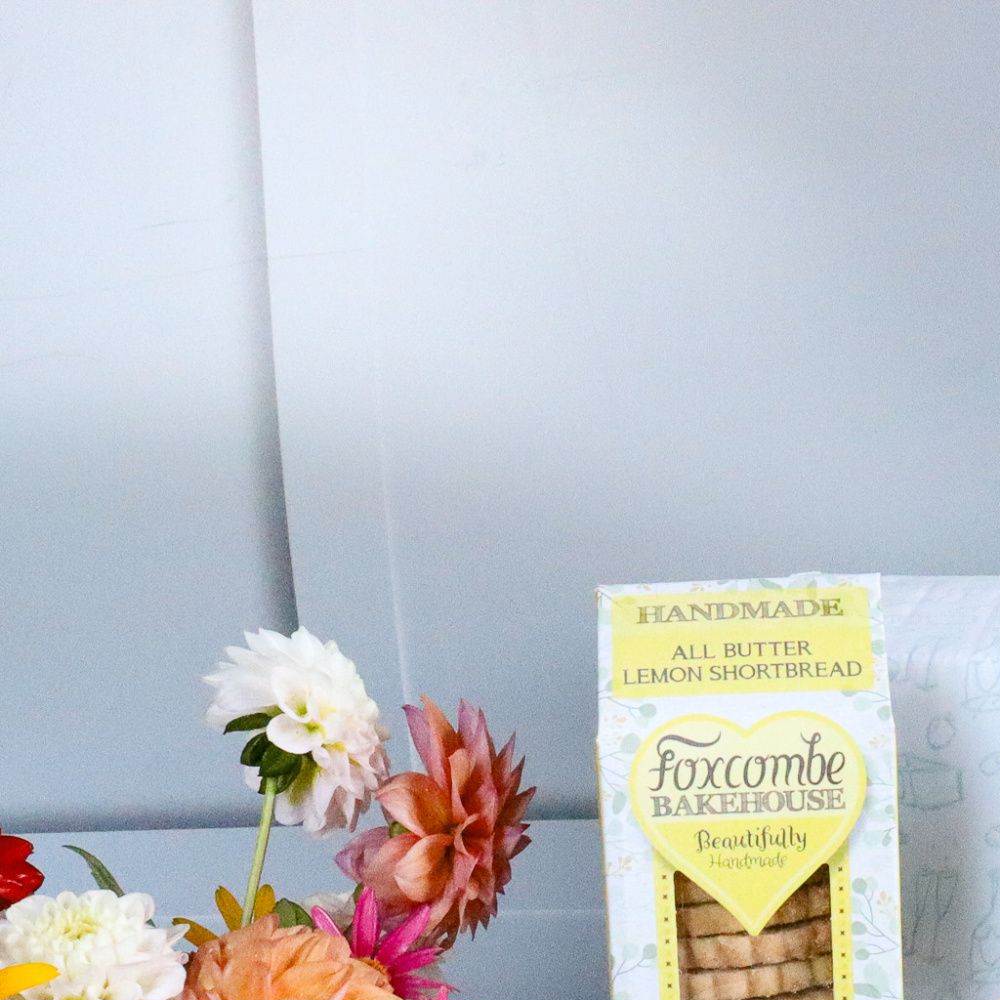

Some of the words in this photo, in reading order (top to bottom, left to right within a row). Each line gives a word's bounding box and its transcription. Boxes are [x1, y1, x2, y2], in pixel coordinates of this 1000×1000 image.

[636, 598, 844, 624] HANDMADE
[671, 644, 716, 661] ALL
[724, 640, 812, 659] BUTTER
[623, 666, 703, 685] LEMON
[710, 660, 862, 681] SHORTBREAD
[650, 788, 846, 817] BAKEHOUSE
[694, 825, 807, 852] Beautifully
